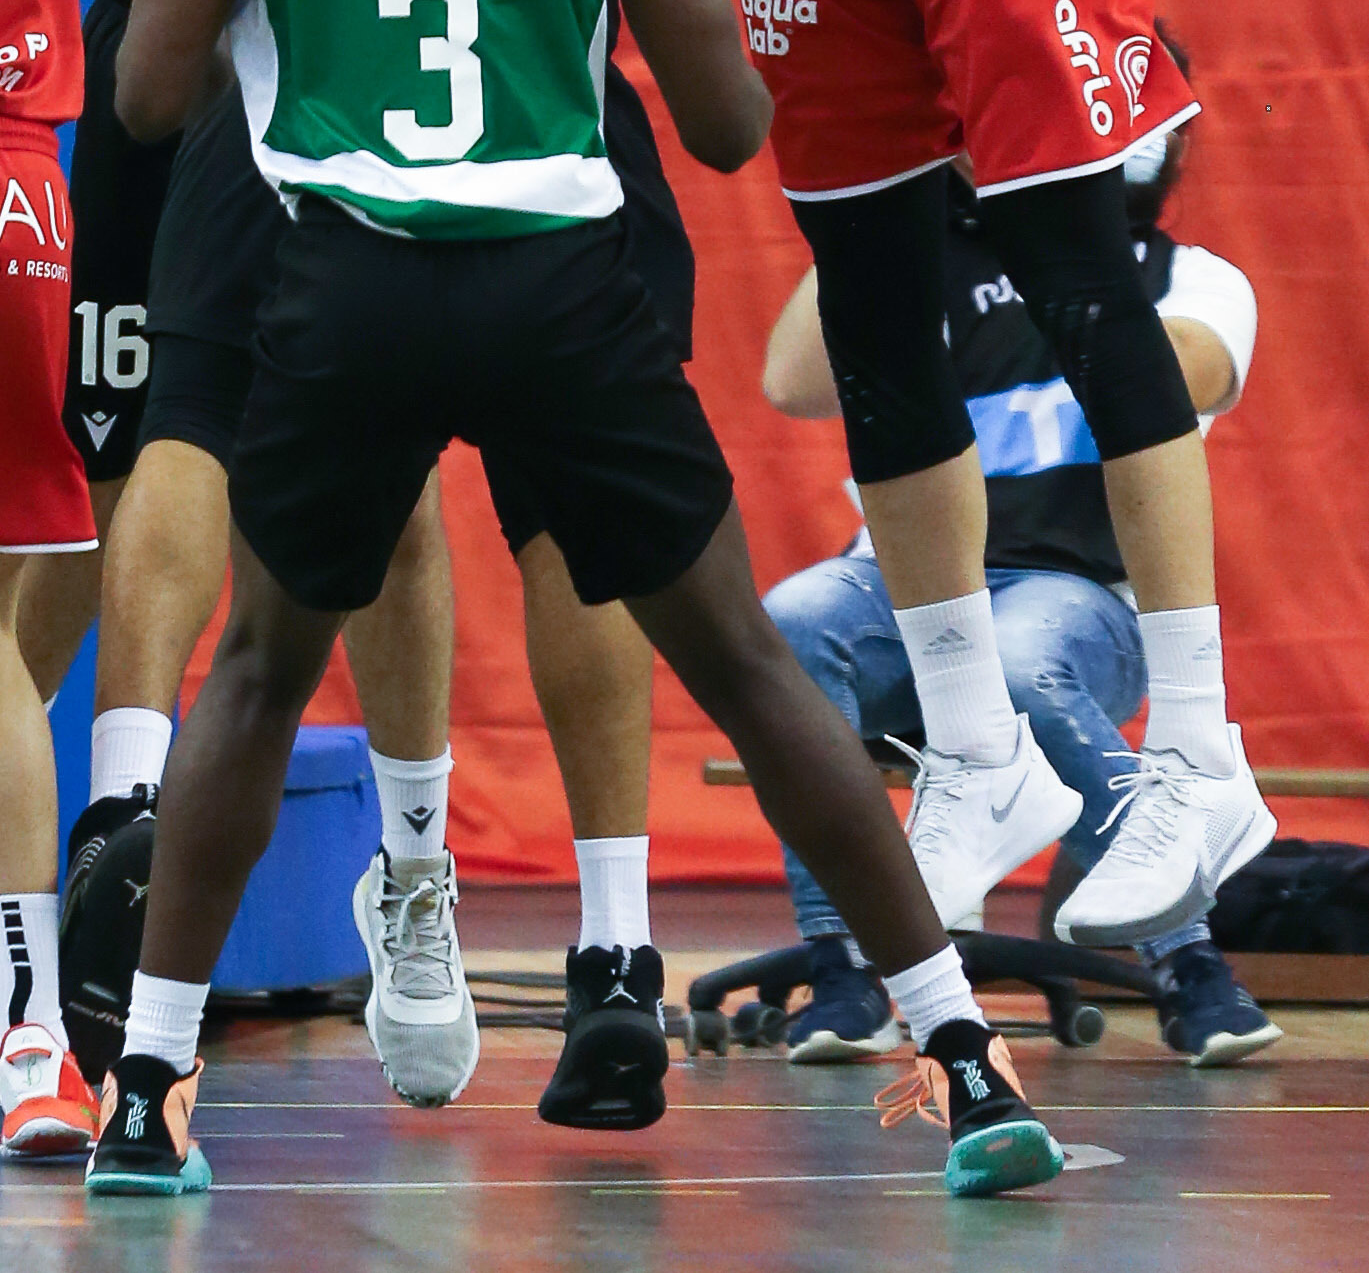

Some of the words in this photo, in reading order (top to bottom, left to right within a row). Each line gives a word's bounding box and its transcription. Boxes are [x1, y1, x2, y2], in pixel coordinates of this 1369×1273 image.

[746, 17, 790, 56] lab
[7, 259, 20, 276] &
[74, 300, 150, 390] 16
